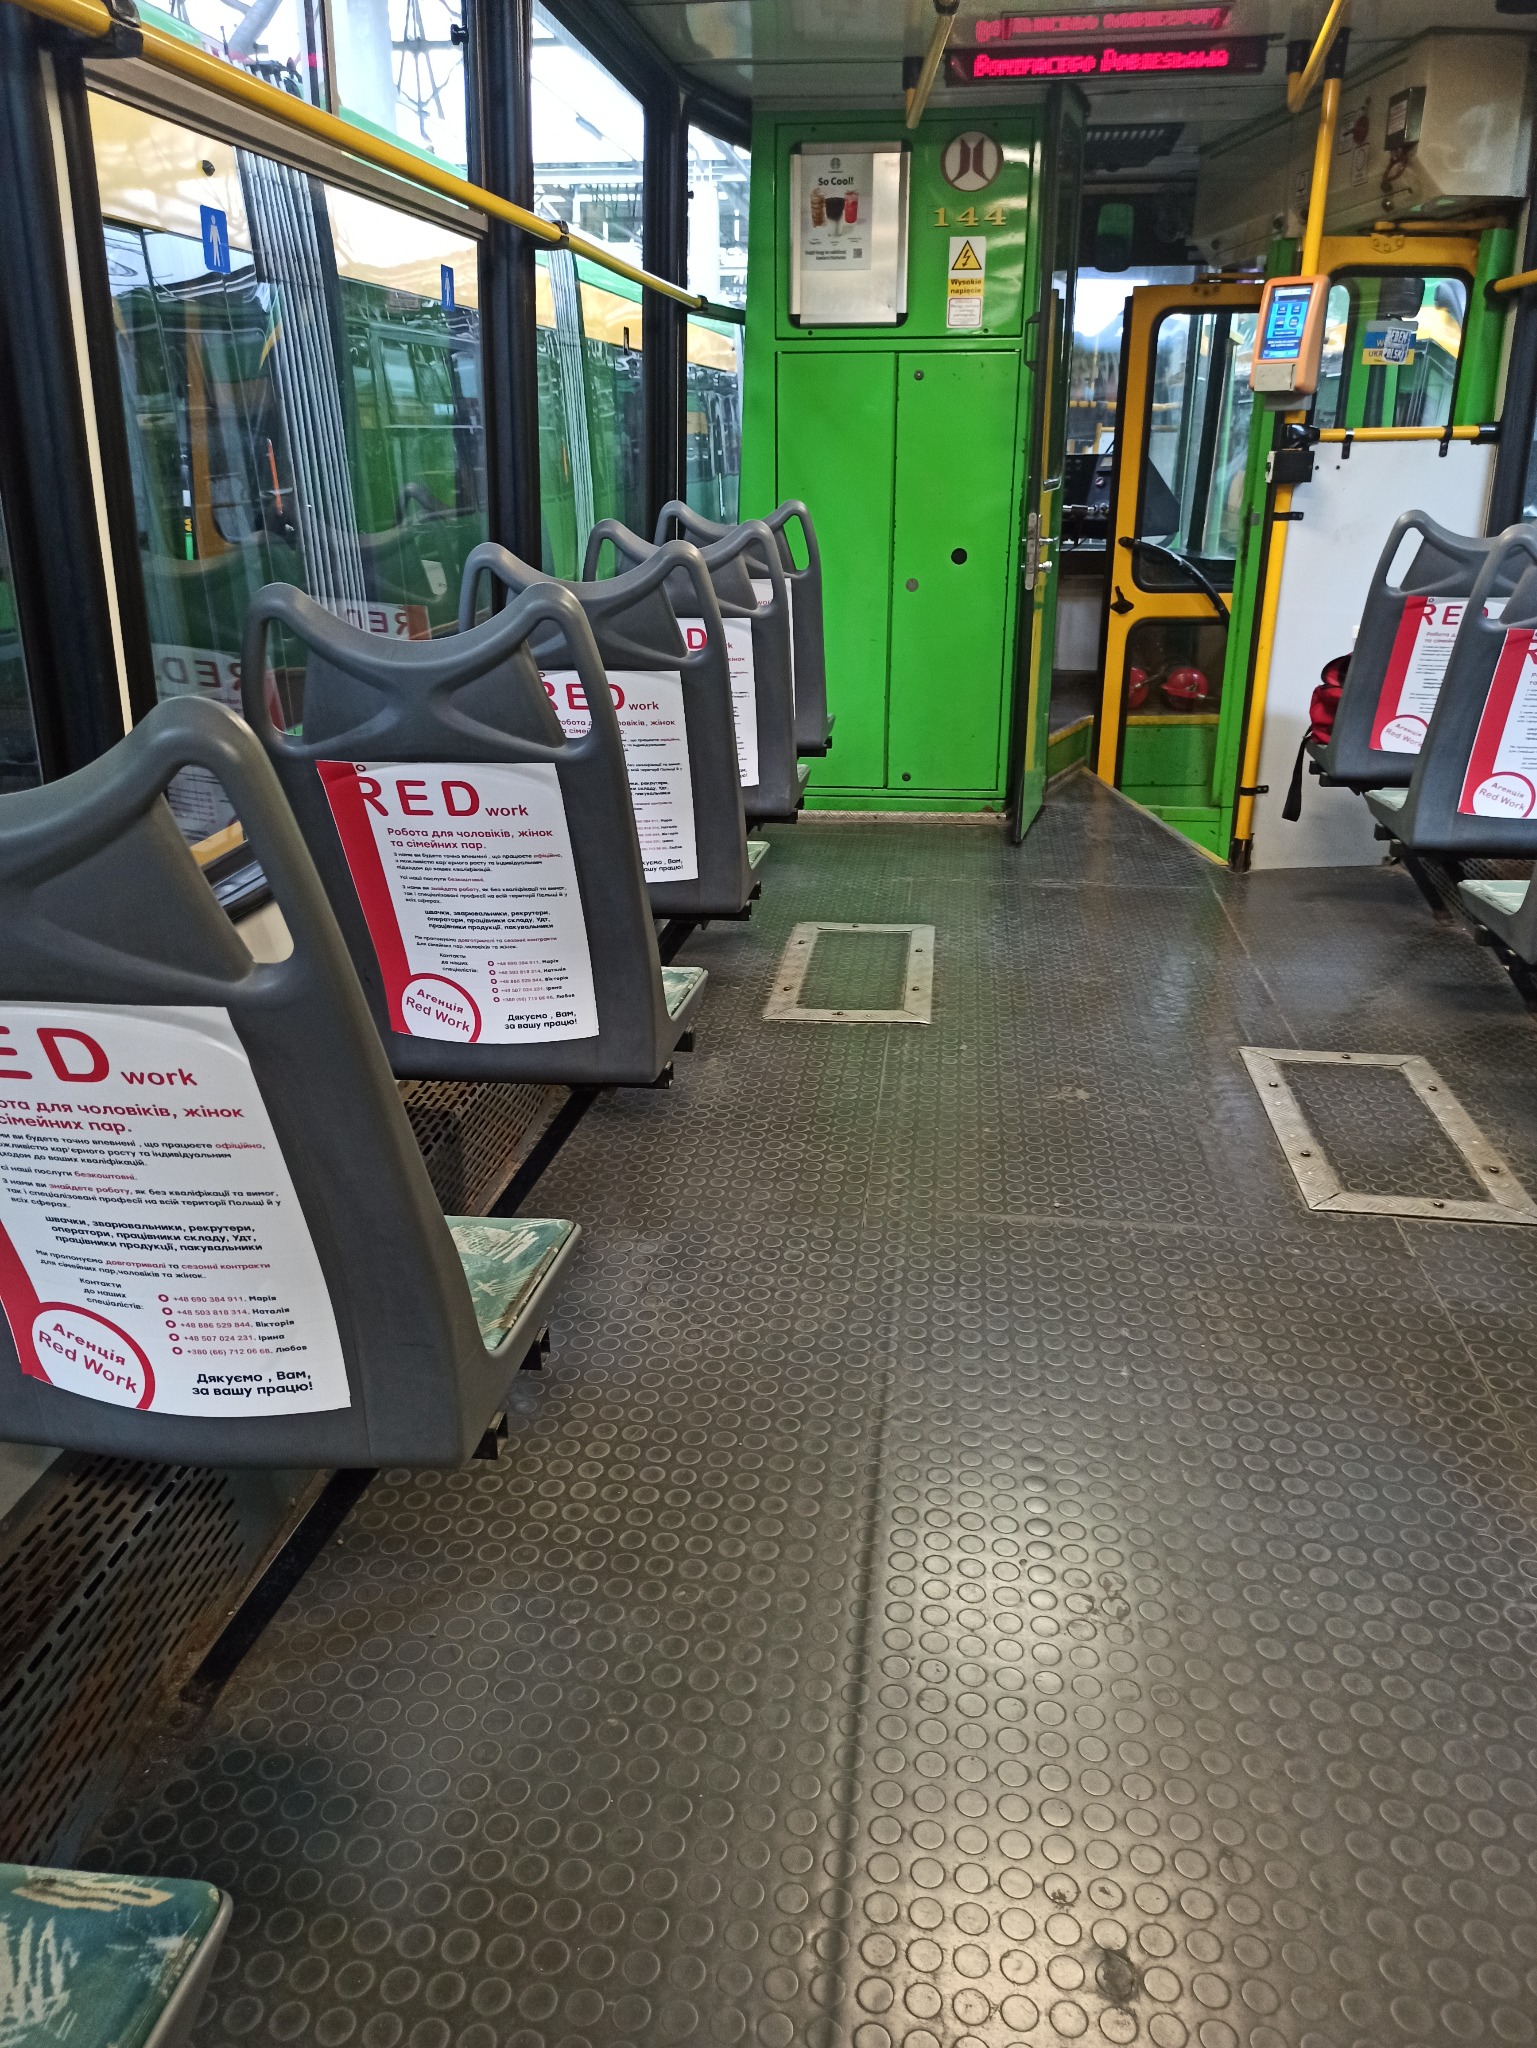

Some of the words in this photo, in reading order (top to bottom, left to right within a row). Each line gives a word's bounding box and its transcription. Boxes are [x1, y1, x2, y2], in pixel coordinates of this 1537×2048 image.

[817, 177, 830, 186] So
[830, 176, 855, 186] Cool!
[933, 206, 1007, 228] 144
[950, 278, 982, 287] Wysokie
[950, 287, 982, 296] napięcie
[628, 701, 660, 711] work
[1385, 727, 1401, 739] Red
[358, 775, 481, 818] RED
[484, 803, 530, 817] work
[1478, 787, 1500, 801] Red
[1499, 796, 1526, 811] Work
[386, 826, 430, 838] Робота
[431, 830, 455, 839] для
[456, 828, 515, 840] чоловіків,
[517, 828, 554, 838] жінок
[390, 839, 404, 848] та
[406, 838, 458, 849] сімейних
[460, 842, 487, 852] пар.
[416, 988, 464, 1015] Агенція
[405, 995, 432, 1017] Red
[435, 1008, 471, 1033] Work
[507, 1013, 548, 1023] Дякуємо
[555, 1010, 577, 1018] Вам,
[504, 1022, 516, 1030] за
[517, 1022, 542, 1030] вашу
[543, 1018, 578, 1029] працю!
[120, 1068, 199, 1087] work
[35, 1101, 74, 1114] для
[76, 1103, 178, 1120] чоловіків,
[182, 1105, 245, 1118] жінок
[87, 1121, 133, 1136] пар.
[25, 1133, 60, 1143] будете
[61, 1137, 91, 1145] точно
[91, 1139, 137, 1147] впевнені
[143, 1141, 160, 1149] що
[161, 1141, 213, 1150] працюєте
[214, 1141, 266, 1151] офіційно,
[33, 1152, 46, 1161] до
[48, 1154, 79, 1163] ваших
[80, 1157, 148, 1167] кваліфікацій.
[107, 1149, 137, 1158] росту
[152, 1150, 232, 1160] індивідуальним
[10, 1166, 33, 1174] наші
[34, 1168, 73, 1177] послуги
[74, 1170, 138, 1181] безкоштовні.
[10, 1179, 34, 1187] нами
[48, 1182, 94, 1193] знайдете
[95, 1186, 133, 1196] роботу,
[148, 1188, 167, 1196] без
[168, 1189, 230, 1198] кваліфікації
[246, 1190, 279, 1198] вимог,
[10, 1196, 29, 1204] всіх
[31, 1198, 71, 1209] сферах.
[28, 1189, 97, 1202] спеціалізовані
[98, 1194, 143, 1205] професії
[159, 1198, 180, 1206] всій
[181, 1199, 227, 1208] території
[228, 1199, 265, 1207] Польщі
[44, 1215, 91, 1227] швачки,
[91, 1220, 187, 1233] зварювальники,
[188, 1225, 256, 1234] рекрутери,
[51, 1225, 115, 1239] оператори,
[115, 1231, 181, 1241] працівники
[183, 1234, 230, 1244] складу,
[231, 1234, 257, 1243] Удт,
[55, 1234, 118, 1248] працівники
[119, 1240, 178, 1252] продукції,
[179, 1244, 263, 1253] пакувальники
[35, 1249, 49, 1257] Ми
[49, 1251, 104, 1265] пропонуємо
[105, 1259, 167, 1270] довготривалі
[219, 1262, 272, 1271] контракти
[40, 1258, 57, 1267] для
[57, 1260, 97, 1273] сімейних
[175, 1271, 207, 1280] жінок.
[78, 1277, 123, 1289] Контакти
[83, 1287, 96, 1295] до
[96, 1290, 127, 1299] наших
[248, 1295, 277, 1303] Марія
[86, 1297, 145, 1310] спеціалістів:
[251, 1307, 291, 1315] Наталія
[255, 1319, 295, 1328] Вікторія
[52, 1322, 126, 1366] Агенція
[257, 1333, 286, 1343] Ірина
[186, 1348, 208, 1356] +380
[209, 1348, 227, 1357] (66)
[228, 1348, 245, 1356] 712
[275, 1344, 308, 1354] Любов
[38, 1329, 77, 1363] Red
[83, 1354, 138, 1394] Work
[196, 1373, 263, 1386] Дякуємо
[275, 1370, 312, 1381] Вам,
[191, 1387, 210, 1396] за
[212, 1387, 253, 1398] вашу
[256, 1380, 314, 1397] працю!
